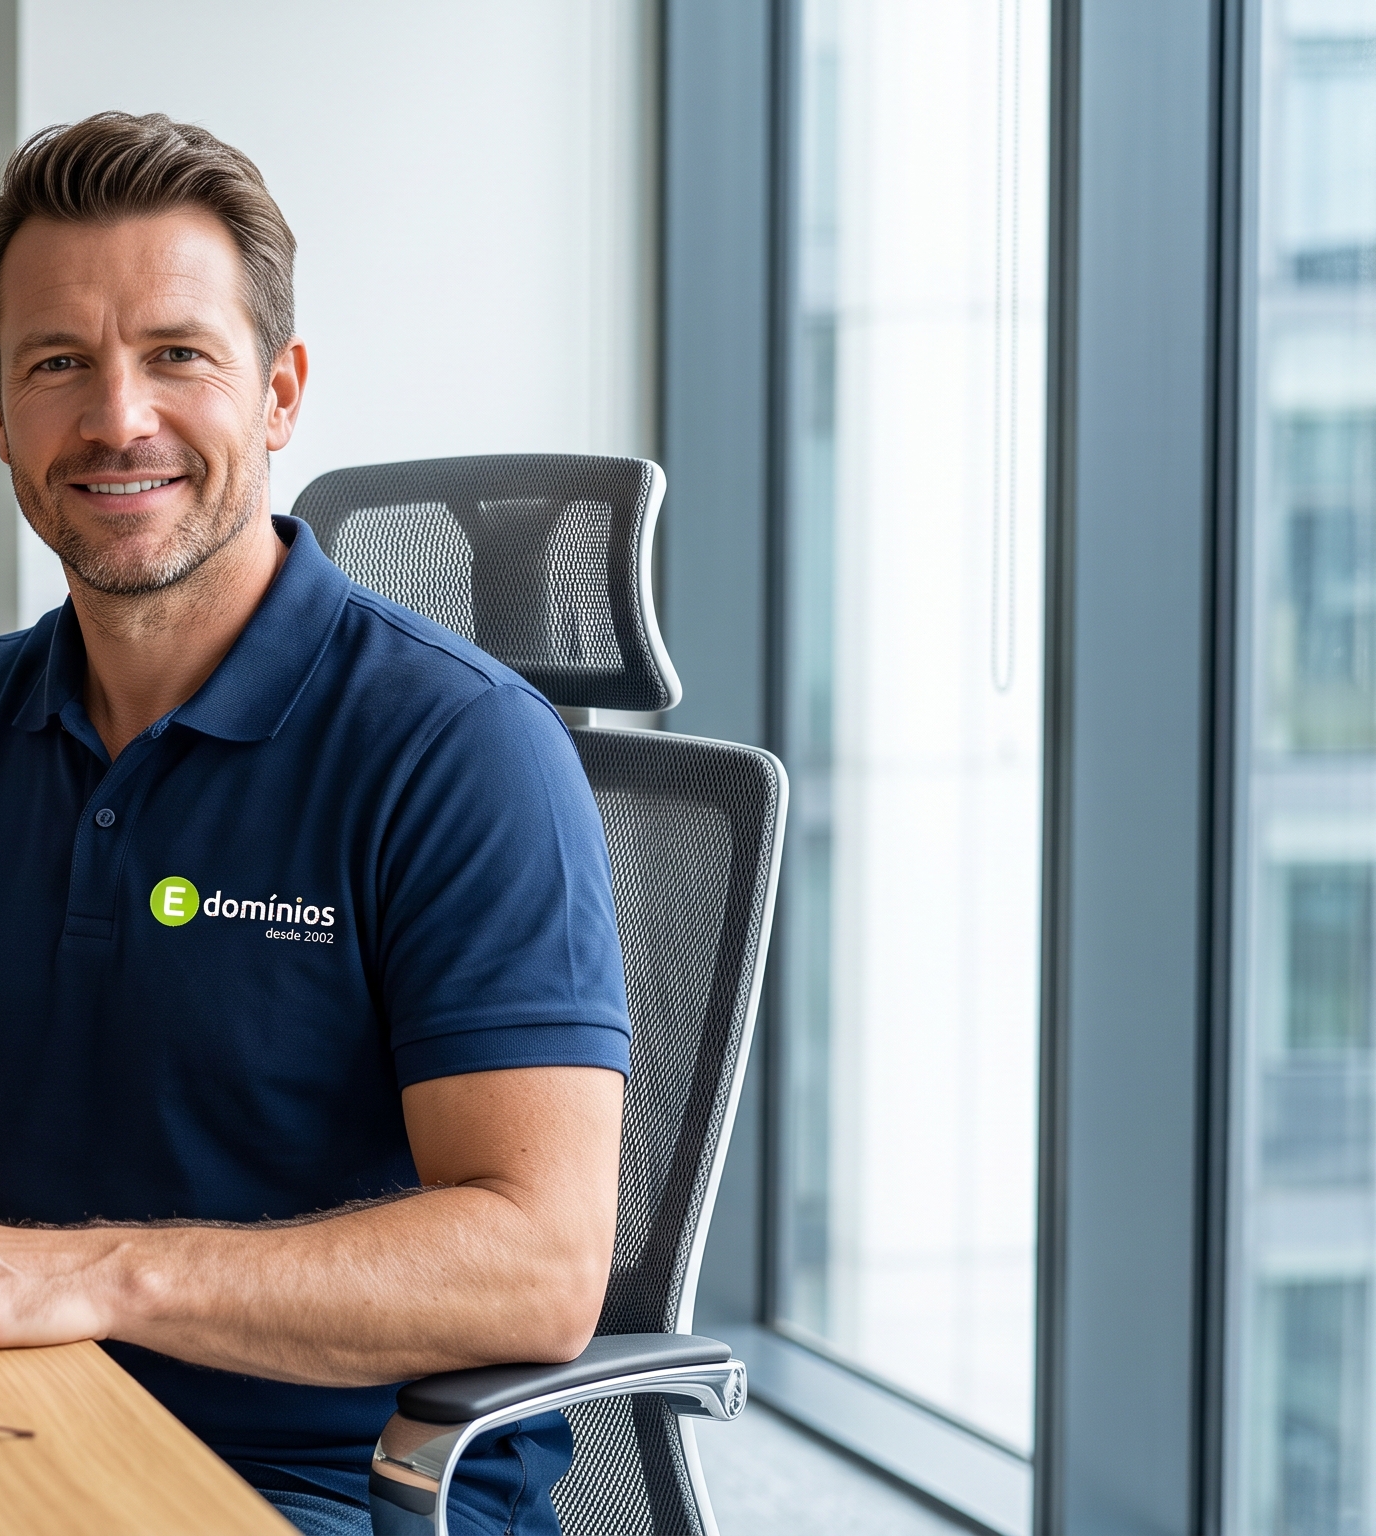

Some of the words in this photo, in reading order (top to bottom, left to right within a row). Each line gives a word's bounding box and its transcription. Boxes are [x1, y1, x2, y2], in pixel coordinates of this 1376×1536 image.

[163, 886, 186, 917] E
[203, 890, 335, 927] domínios
[265, 927, 301, 941] desde
[304, 930, 334, 944] 2002
